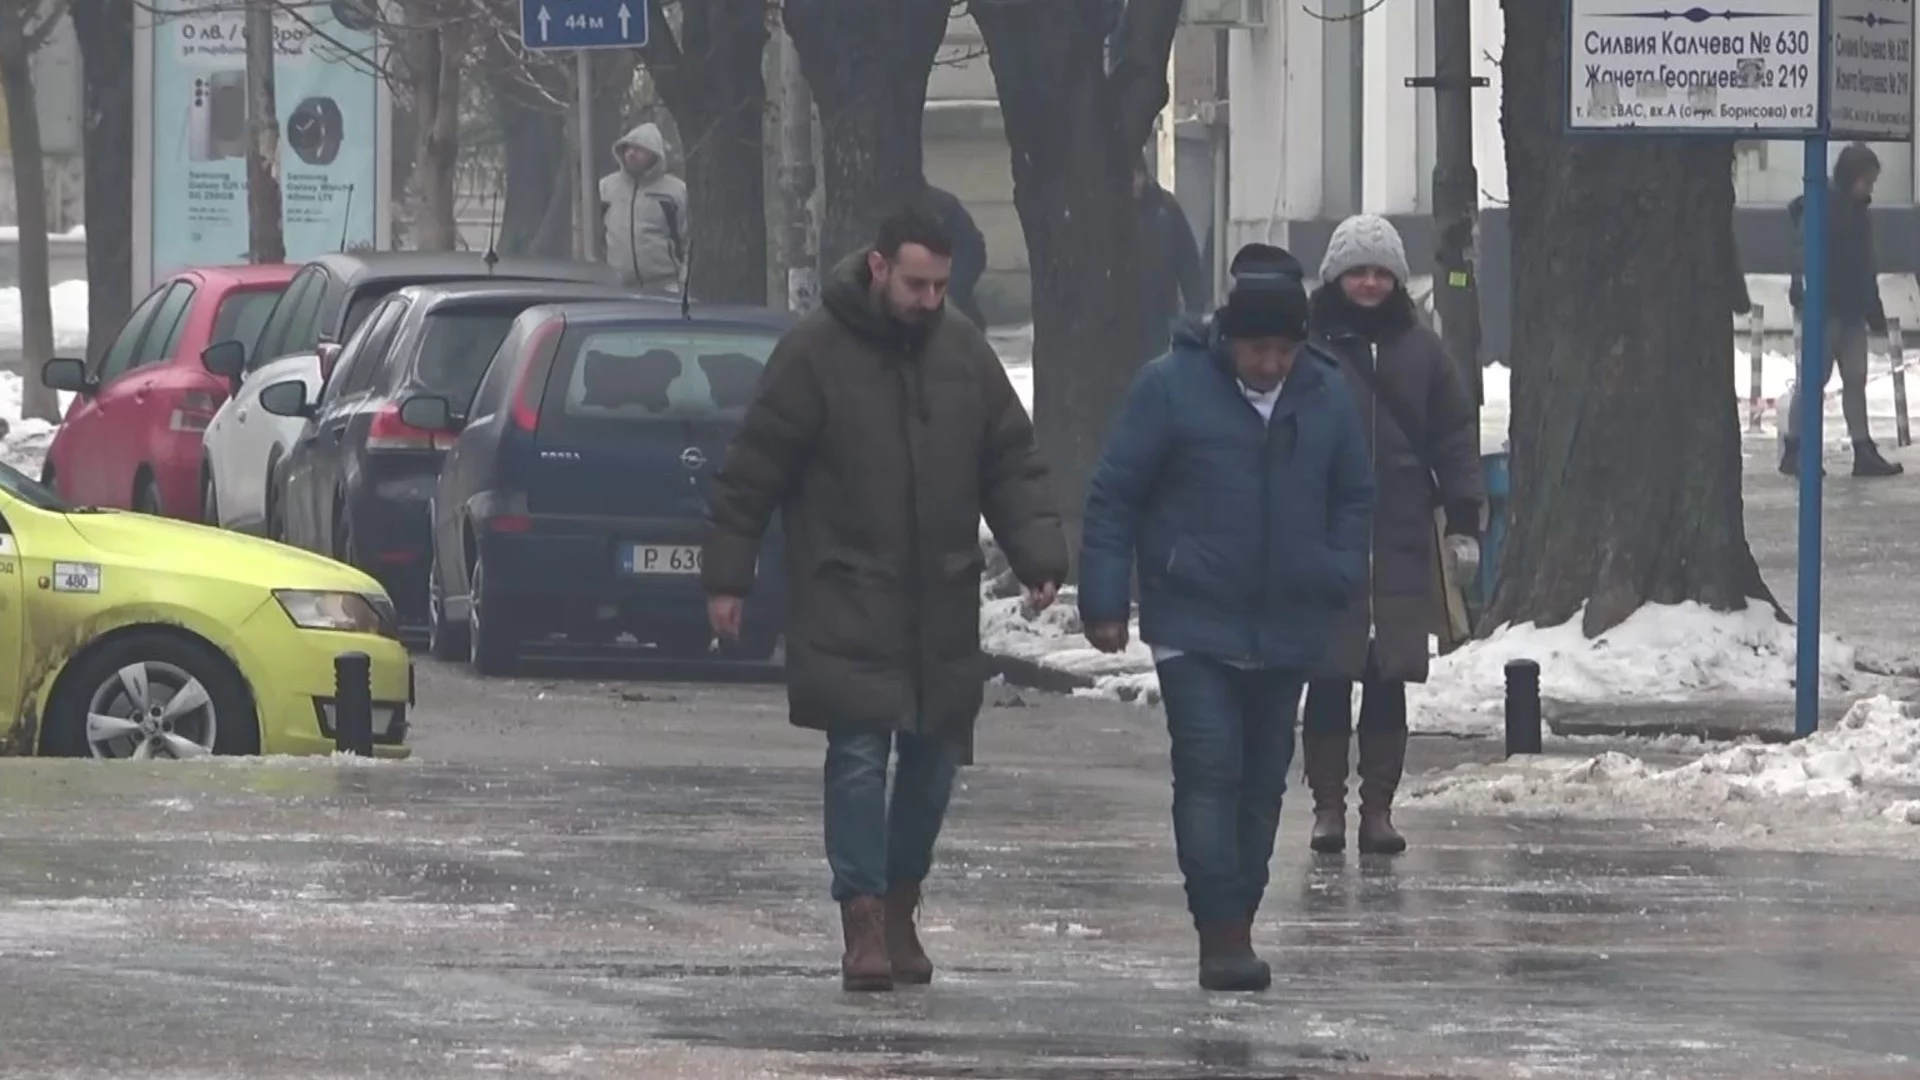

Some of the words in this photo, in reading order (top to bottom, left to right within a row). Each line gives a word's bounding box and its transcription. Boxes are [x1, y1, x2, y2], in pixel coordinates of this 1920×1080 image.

[1584, 30, 1656, 55] Силвия
[1662, 30, 1744, 54] Калчева
[1776, 30, 1809, 55] 630
[1660, 63, 1740, 90] Георгиев
[1778, 64, 1808, 88] 219
[1720, 103, 1787, 120] Борисова)
[65, 574, 88, 589] 480
